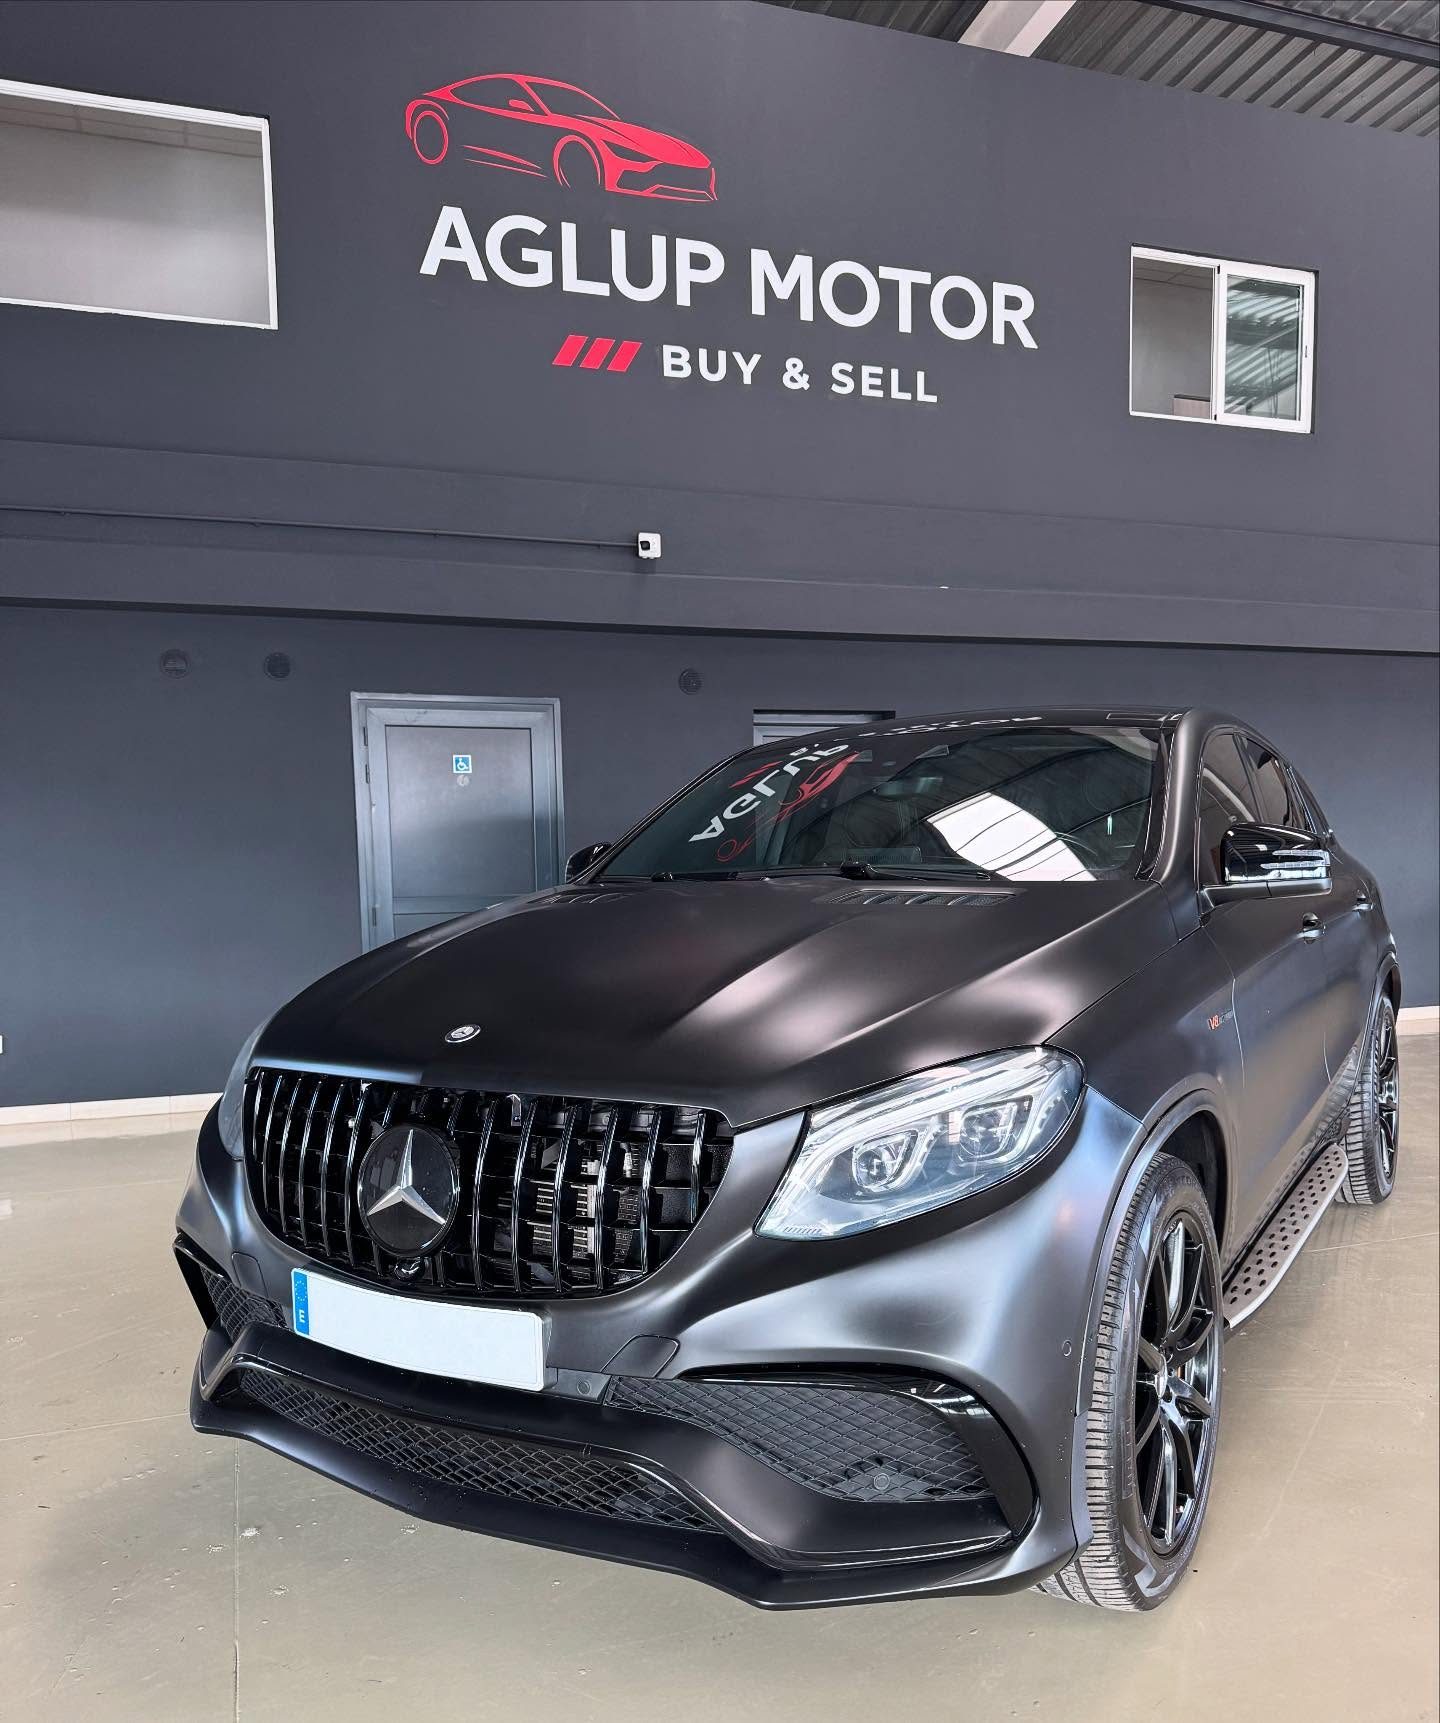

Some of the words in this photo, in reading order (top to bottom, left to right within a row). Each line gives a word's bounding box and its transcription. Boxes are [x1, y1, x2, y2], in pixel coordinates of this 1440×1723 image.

[419, 204, 726, 307] AGLUP
[750, 247, 1040, 350] MOTOR
[662, 343, 762, 385] BUY
[781, 356, 811, 391] &
[830, 361, 938, 403] SELL
[299, 1309, 305, 1323] E
